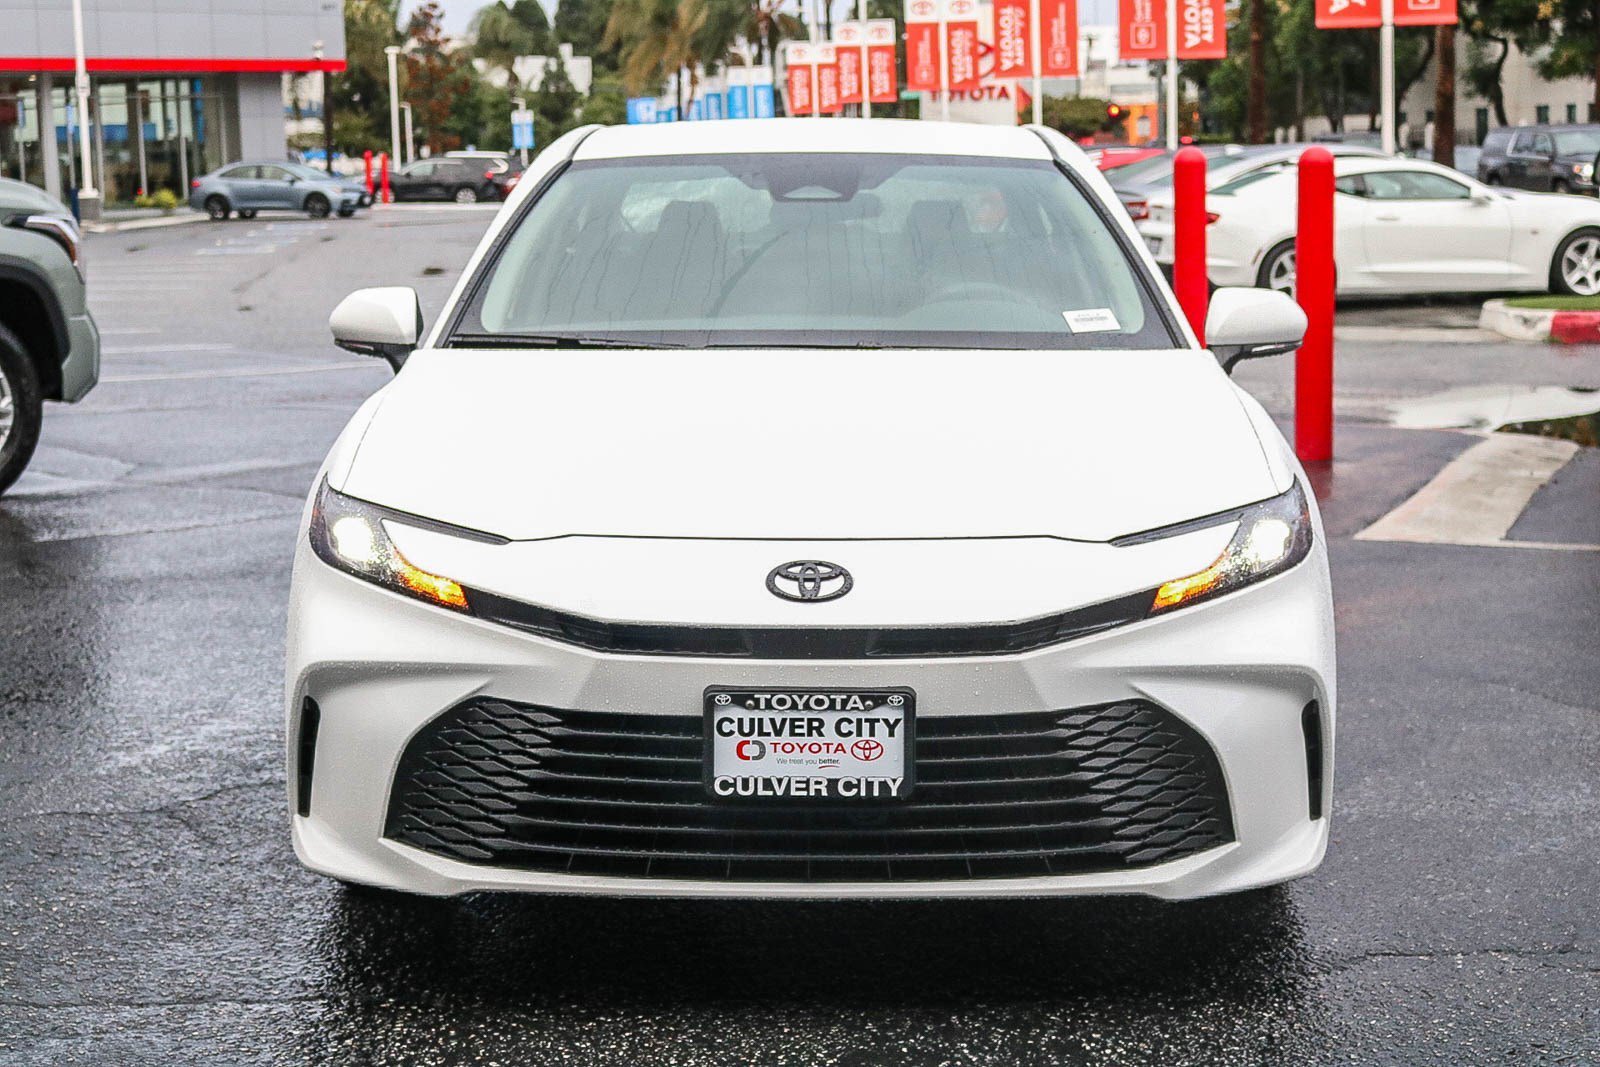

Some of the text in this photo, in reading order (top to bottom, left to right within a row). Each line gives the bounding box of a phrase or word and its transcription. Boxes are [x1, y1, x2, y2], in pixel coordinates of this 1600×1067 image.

[1201, 6, 1214, 43] CITY
[999, 5, 1014, 71] TOYOTA
[754, 694, 865, 710] TOYOTA
[716, 717, 902, 738] CULVER CITY
[770, 742, 847, 754] TOYOTA
[714, 776, 904, 797] CULVER CITY
